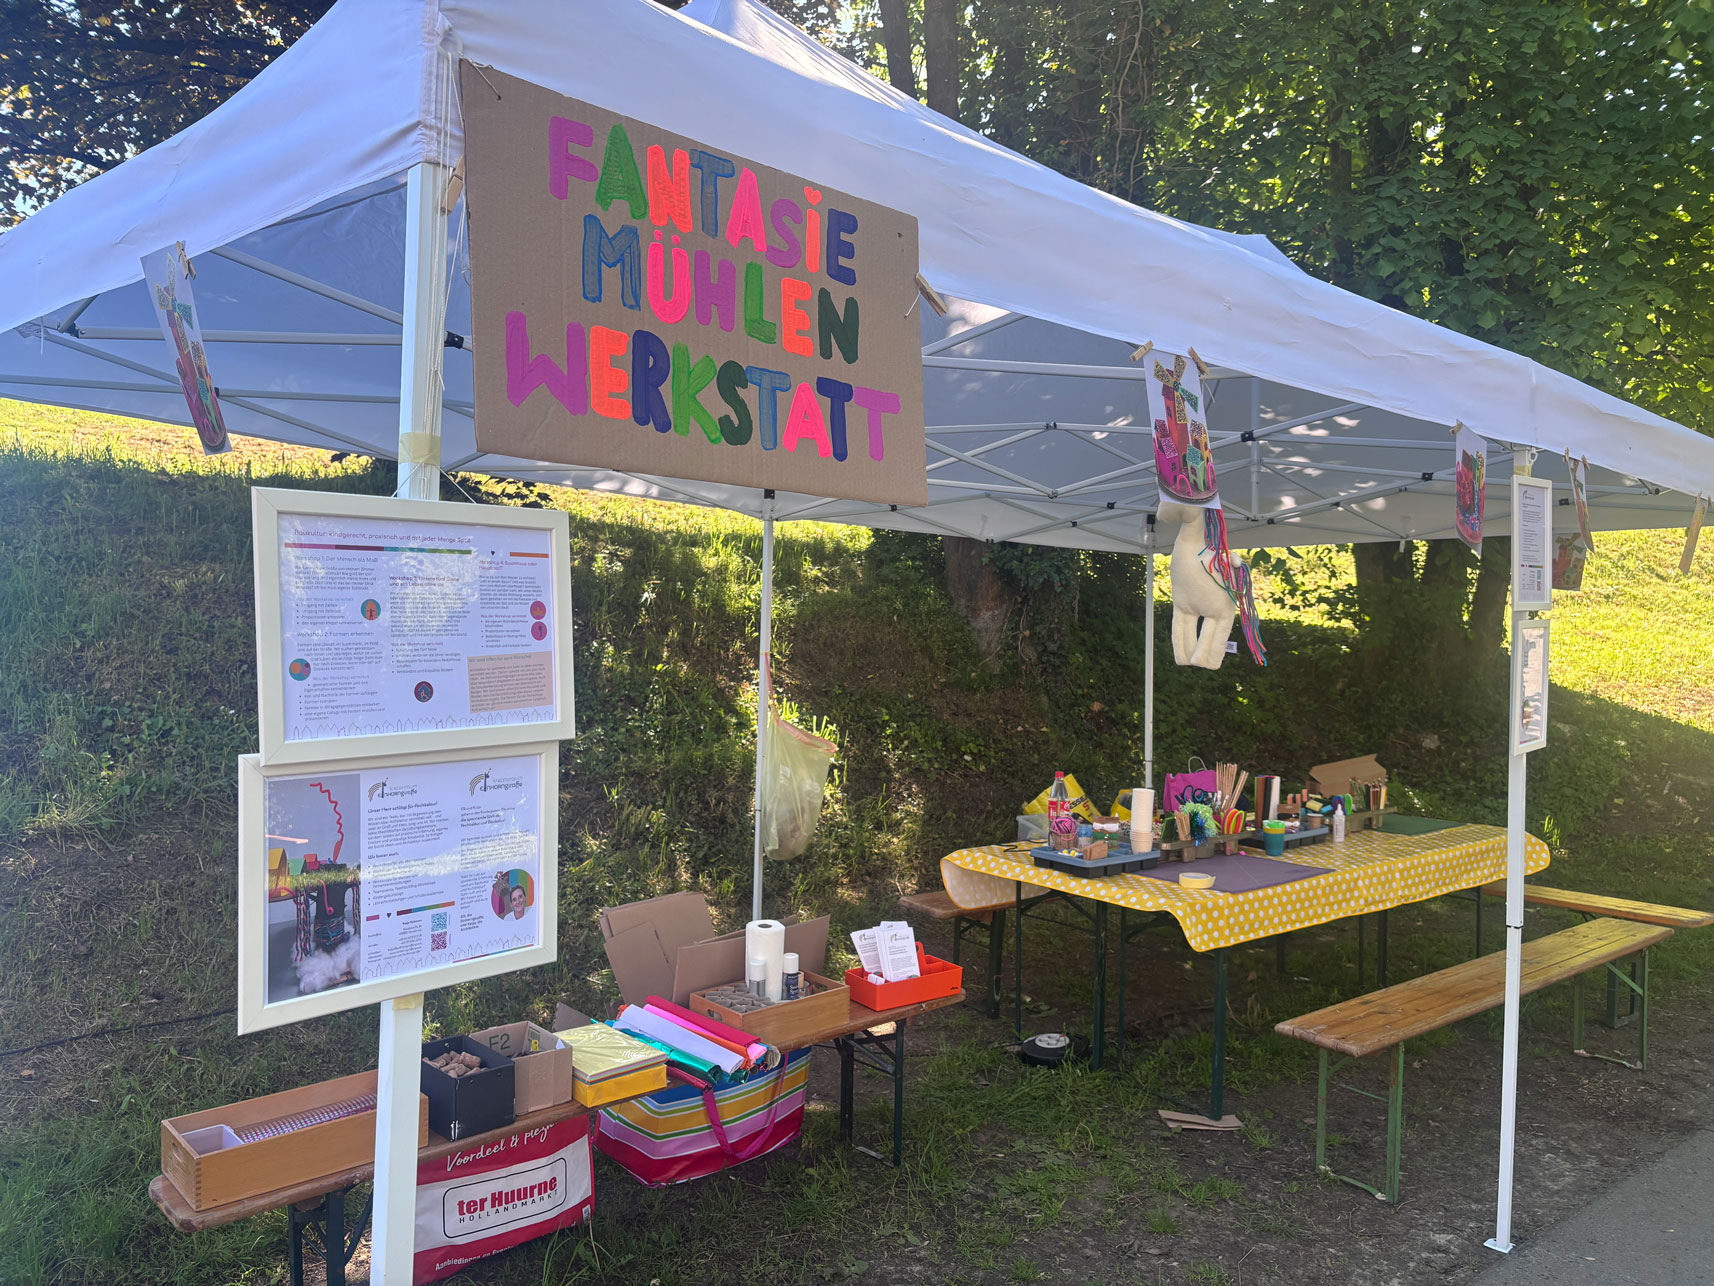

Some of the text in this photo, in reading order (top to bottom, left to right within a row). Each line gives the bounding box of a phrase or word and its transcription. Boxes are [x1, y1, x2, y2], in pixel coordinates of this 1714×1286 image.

[582, 214, 859, 364] MÜHLEN
[505, 311, 901, 462] WERKSTATT
[421, 535, 437, 543] jeder
[489, 1033, 511, 1050] F2
[447, 1139, 507, 1172] Voordeel
[457, 1176, 558, 1216] ter Huurne
[459, 1188, 559, 1224] HOLLANDMARKT
